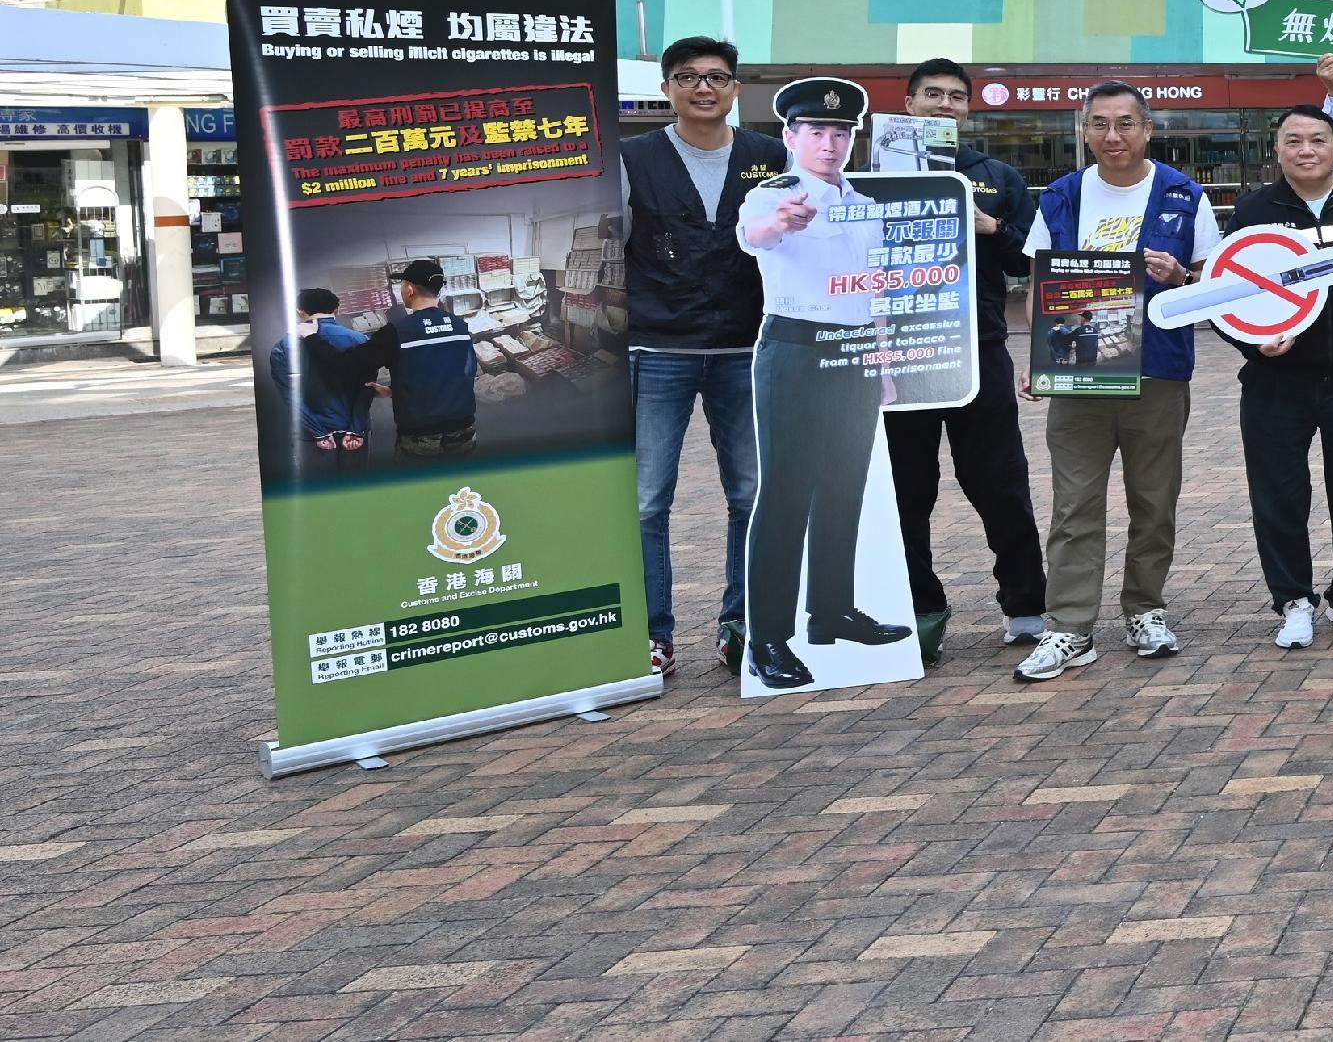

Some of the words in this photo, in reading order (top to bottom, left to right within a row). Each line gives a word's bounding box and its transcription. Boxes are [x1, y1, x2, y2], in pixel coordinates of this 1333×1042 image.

[260, 6, 424, 39] 買賣私煙
[447, 12, 595, 44] 均屬違法
[262, 43, 322, 60] Buying
[326, 45, 345, 58] or
[350, 44, 404, 60] selling
[452, 47, 530, 63] cigarettes
[533, 49, 547, 61] is
[551, 49, 595, 64] illegal
[1156, 86, 1203, 100] HONG
[338, 96, 535, 130] 最高刑罰已提高至
[301, 182, 322, 196] $2
[325, 177, 377, 194] million
[438, 168, 449, 180] 7
[496, 154, 589, 174] imprisonment
[828, 199, 957, 222] 帶超額煙酒入境
[886, 218, 959, 243] 不報關
[867, 243, 959, 268] 罰款最少
[828, 265, 960, 296] HK$5,000
[869, 292, 960, 317] 甚或坐監
[816, 324, 896, 342] Undeclared
[901, 319, 961, 333] excessive
[840, 341, 877, 353] liquor
[879, 340, 893, 349] or
[896, 335, 946, 348] tobacco
[862, 348, 935, 366] HK$5,000
[864, 368, 878, 378] to
[881, 360, 962, 376] imprisonment
[417, 563, 523, 595] 香港海關
[400, 596, 440, 609] Customs
[441, 592, 458, 602] and
[460, 589, 487, 599] Excise
[488, 580, 539, 594] Department
[389, 625, 419, 638] 182
[422, 615, 460, 631] 8080
[390, 612, 617, 663] crimereport@customs.gov.hk
